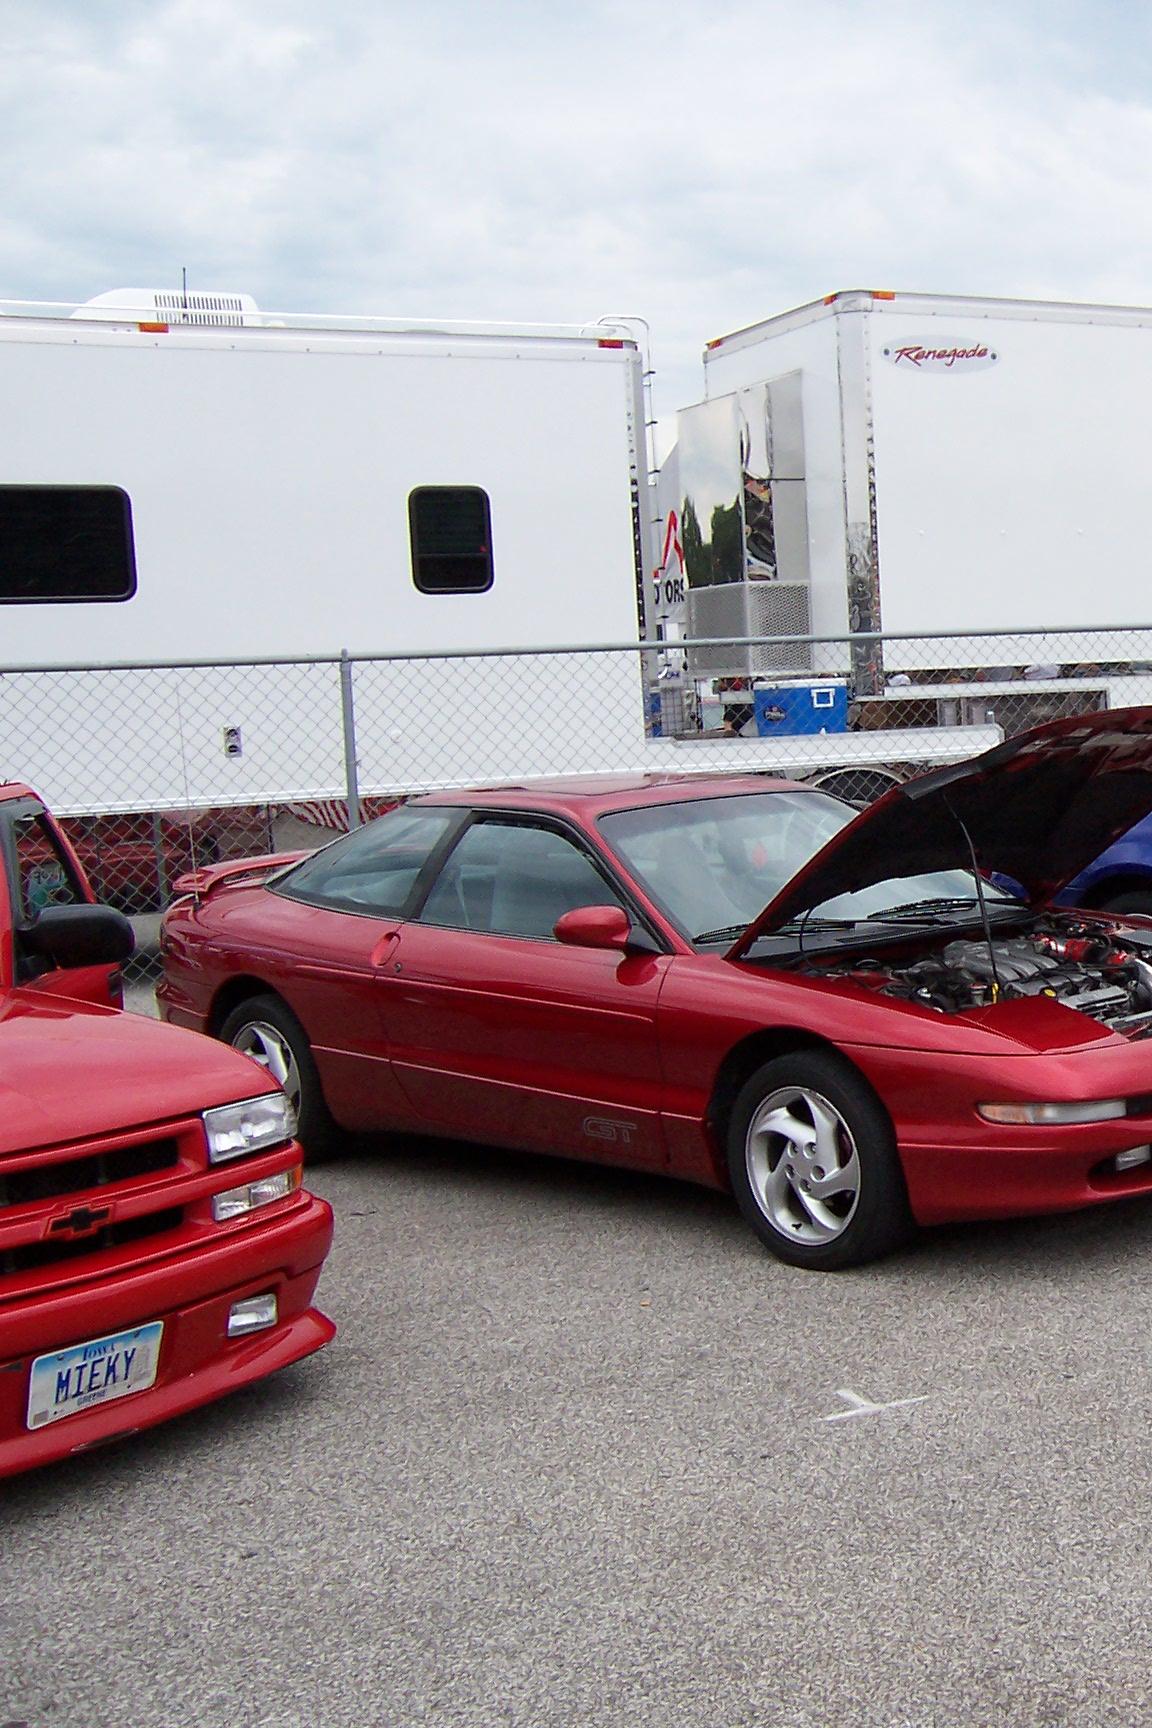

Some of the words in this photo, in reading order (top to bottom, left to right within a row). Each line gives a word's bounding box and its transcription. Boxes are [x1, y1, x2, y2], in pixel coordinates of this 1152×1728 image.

[894, 343, 988, 367] Renegade
[583, 1116, 637, 1143] GT
[55, 1347, 136, 1405] MIEKY
